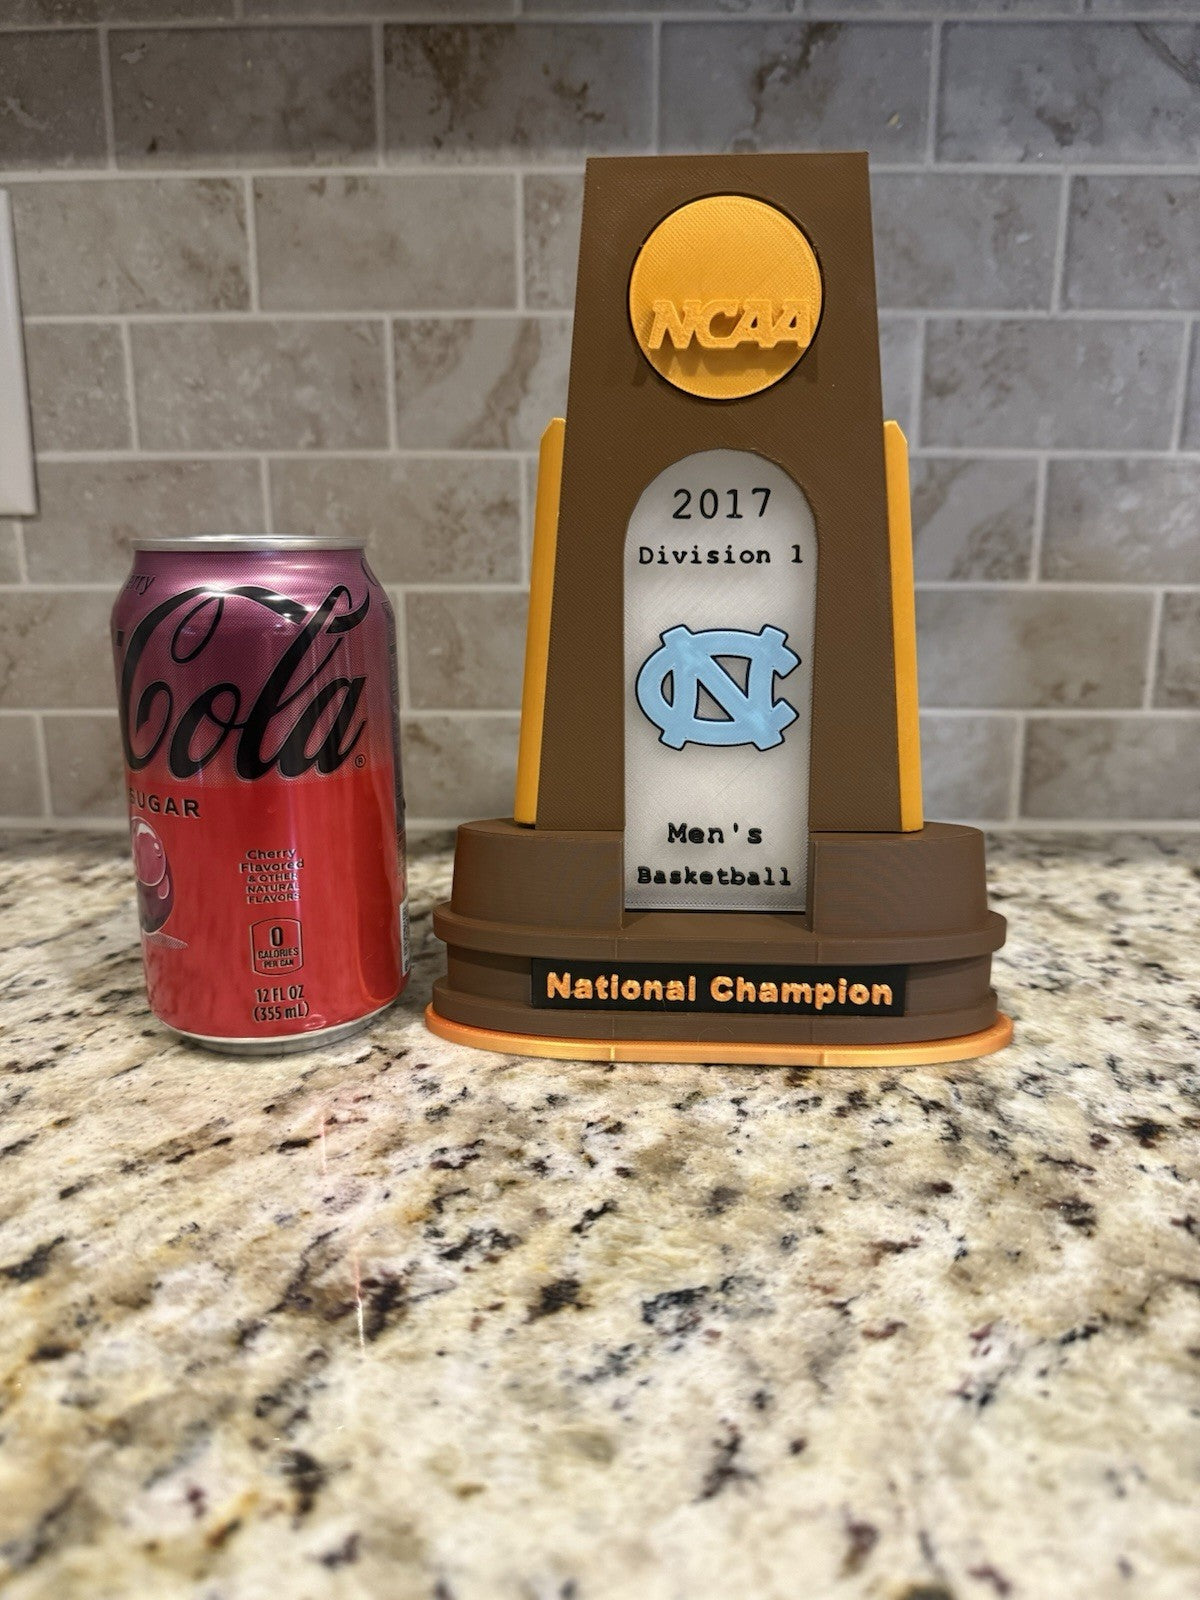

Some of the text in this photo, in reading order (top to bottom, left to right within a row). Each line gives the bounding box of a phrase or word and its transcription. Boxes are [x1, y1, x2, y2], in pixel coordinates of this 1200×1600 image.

[648, 299, 811, 350] NCAA
[672, 488, 771, 519] 2017
[638, 545, 804, 565] Division 1
[128, 786, 201, 819] SUGAR
[667, 822, 764, 845] Men's
[246, 849, 297, 860] Cherry
[239, 858, 305, 873] Flavored
[258, 873, 298, 883] OTHER
[637, 865, 792, 887] Basketball
[246, 882, 300, 894] NATURAL
[247, 891, 301, 904] FLAVORS
[269, 926, 284, 948] 0
[257, 947, 300, 959] CALORIES
[263, 959, 295, 968] PER CAN
[256, 984, 305, 1003] 12 FL OZ
[546, 972, 894, 1012] National Champion
[253, 1001, 310, 1022] (355 mL)
